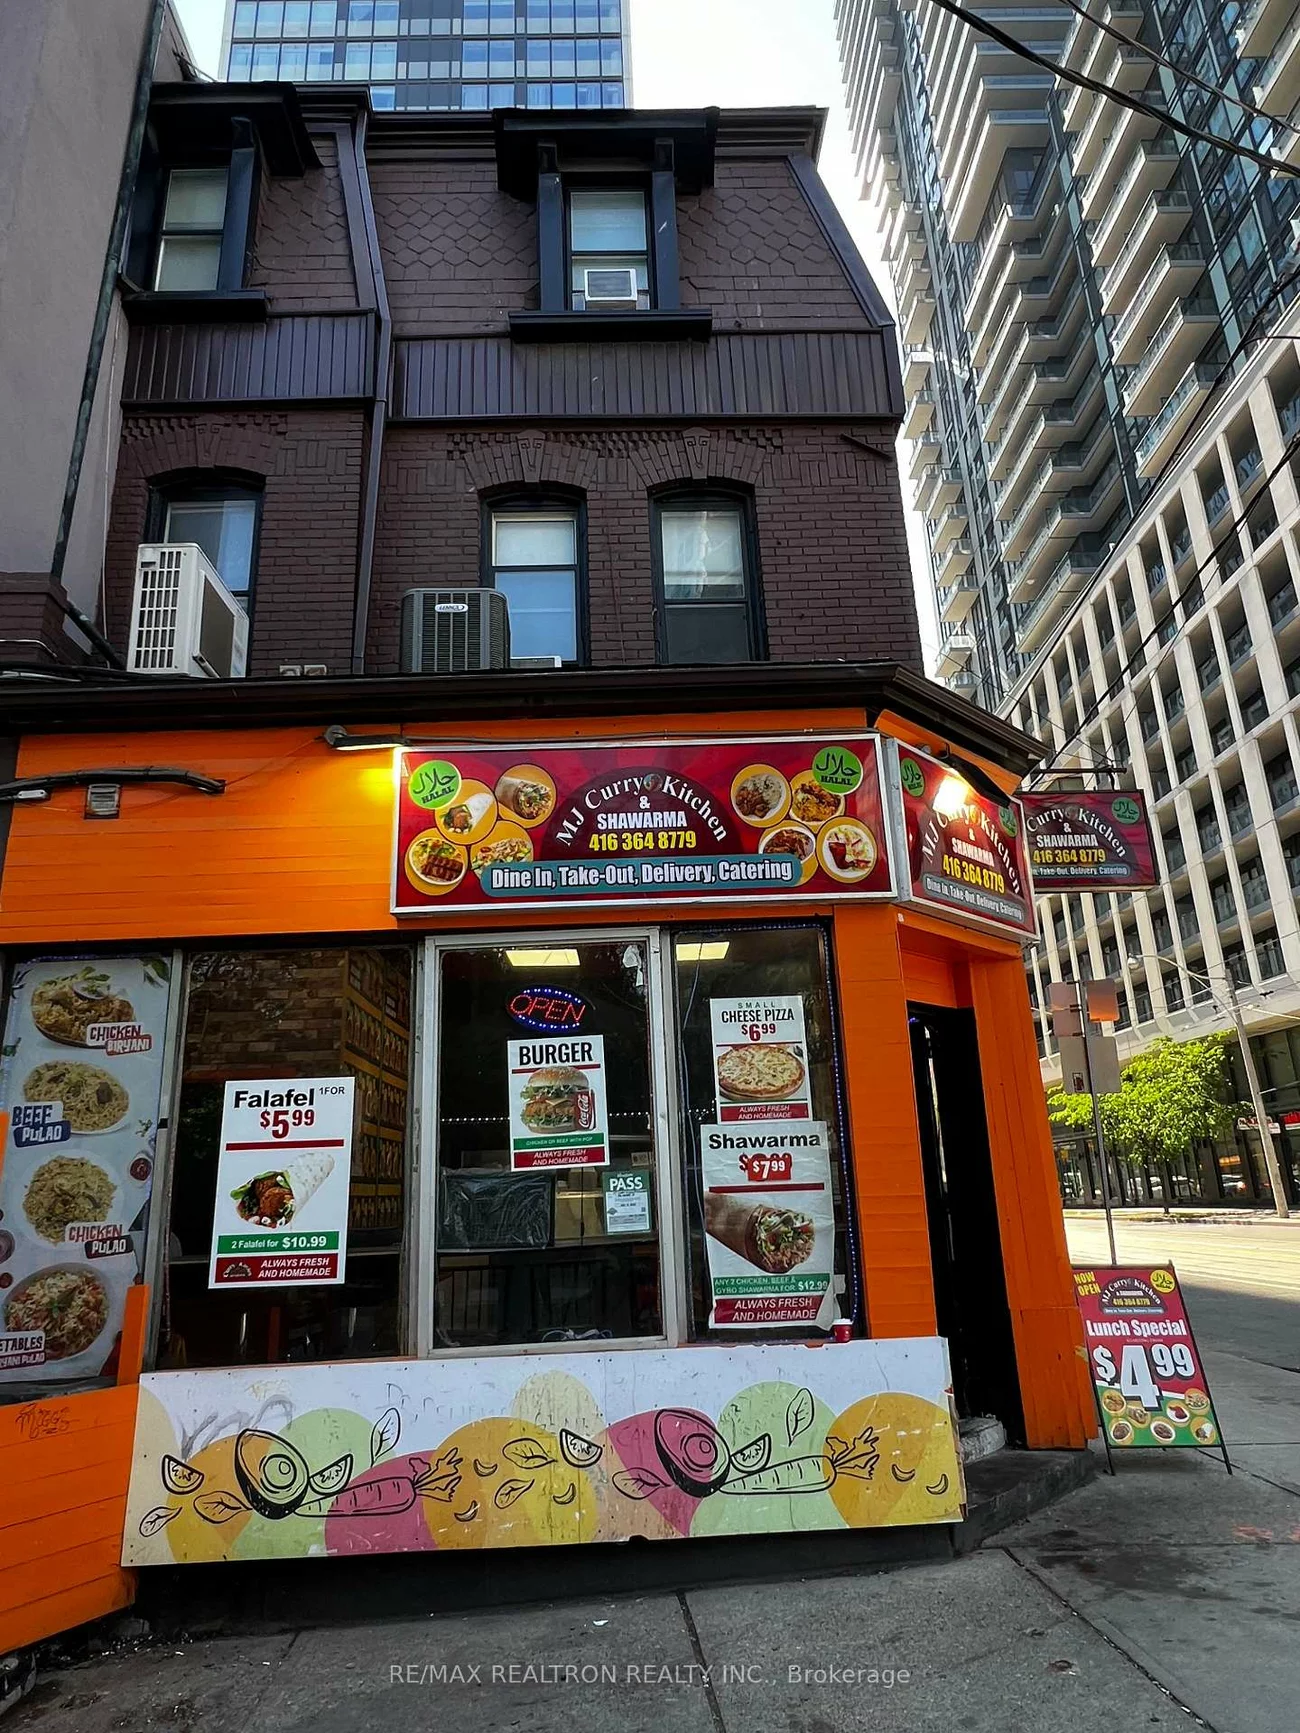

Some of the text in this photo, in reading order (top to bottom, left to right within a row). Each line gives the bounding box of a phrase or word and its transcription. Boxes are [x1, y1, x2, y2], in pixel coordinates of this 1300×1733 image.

[815, 752, 859, 778] حلال
[412, 767, 457, 796] حلال
[820, 775, 853, 786] HALAL
[421, 786, 455, 804] HALAL
[639, 795, 650, 809] &
[556, 775, 727, 847] MJ Curry Kitchen
[597, 811, 688, 830] SHAWARMA
[1063, 822, 1072, 833] &
[589, 830, 697, 851] 416 364 8779
[1026, 808, 1064, 832] Curry
[1078, 808, 1126, 857] Kitchen
[1036, 834, 1098, 847] SHAWARMA
[951, 837, 995, 867] SHAWARMA
[980, 810, 1020, 894] Kitchen
[1033, 849, 1106, 863] 416 364 8779
[492, 859, 793, 889] Dine In, Take-Out, Delivery, Catering
[943, 854, 1005, 894] 416 364 8779
[509, 994, 586, 1024] OPEN
[737, 1001, 776, 1009] SMALL
[721, 1008, 795, 1023] CHEESE PIZZA
[89, 1024, 142, 1042] CHICKEN
[107, 1038, 150, 1054] BIRYANI
[519, 1042, 593, 1066] BURGER
[234, 1088, 315, 1109] Falafel
[11, 1104, 53, 1126] BEEF
[753, 1111, 792, 1120] HOMEMADE
[767, 1104, 790, 1112] FRESH
[21, 1126, 62, 1142] PULAO
[708, 1133, 821, 1150] Shawarma
[532, 1156, 589, 1166] AND HOMEMADE
[534, 1149, 587, 1159] ALWAYS FRESH
[610, 1176, 643, 1191] PASS
[68, 1223, 123, 1243] CHICKEN
[91, 1238, 127, 1254] PULAO
[231, 1235, 327, 1249] 2 Falafel for $10.99
[261, 1257, 330, 1269] ALWAYS FRESH
[258, 1269, 278, 1279] AND
[278, 1267, 331, 1278] HOMEMADE
[798, 1281, 828, 1292] $12.99
[1073, 1271, 1101, 1297] NOW OPEN
[1134, 1279, 1161, 1305] Kitchen
[735, 1298, 813, 1309] ALWAYS FRESH
[732, 1309, 817, 1321] AND HOMEMADE
[1086, 1319, 1187, 1338] Lunch Special
